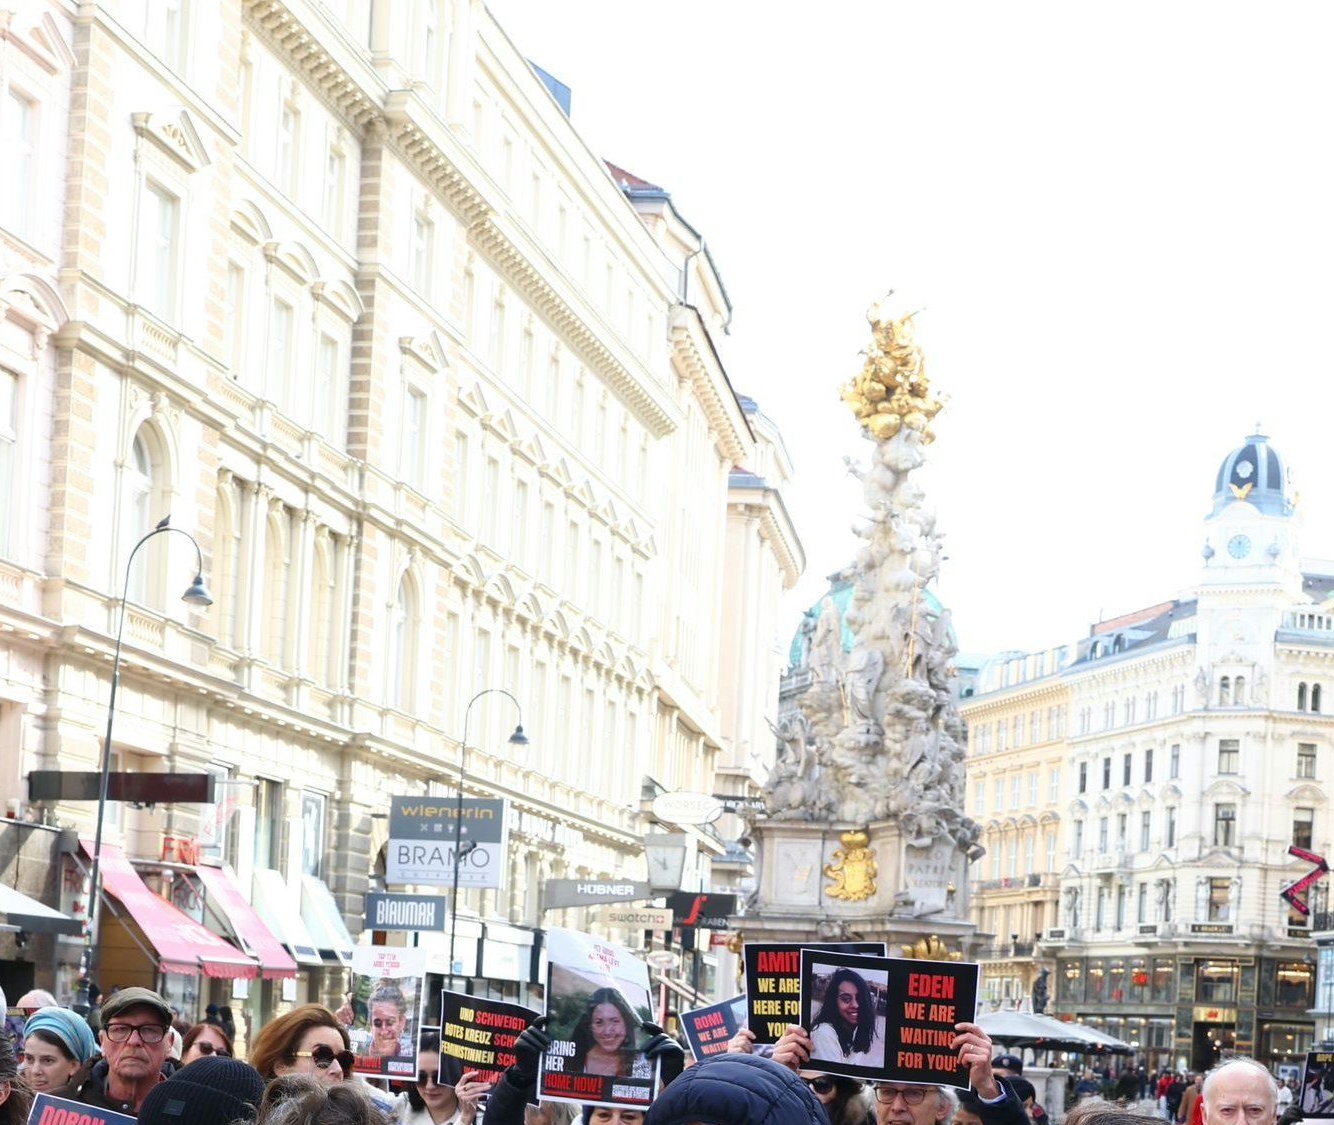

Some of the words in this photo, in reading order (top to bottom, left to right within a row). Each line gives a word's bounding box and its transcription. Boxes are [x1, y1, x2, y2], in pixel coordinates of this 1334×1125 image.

[400, 804, 494, 819] wienerin
[576, 883, 635, 896] HÜBNER
[609, 908, 657, 924] swatch
[757, 950, 800, 973] AMIT
[757, 977, 777, 993] WE
[779, 977, 800, 993] ARE
[907, 973, 955, 999] EDEN
[753, 1000, 782, 1015] HERE
[904, 1002, 925, 1020] WE
[929, 1005, 956, 1024] ARE
[459, 1007, 474, 1022] UNO
[475, 1010, 526, 1031] SCHWEIGT!
[693, 1011, 724, 1030] ROMI
[444, 1022, 464, 1040] ROTES
[464, 1027, 492, 1045] KREUZ
[697, 1030, 712, 1042] WE
[712, 1027, 729, 1039] ARE
[900, 1026, 957, 1046] WAITING
[545, 1056, 564, 1072] HER
[897, 1051, 923, 1068] FOR
[928, 1053, 957, 1073] YOU!
[544, 1072, 572, 1091] HOME
[573, 1076, 603, 1094] NOW!
